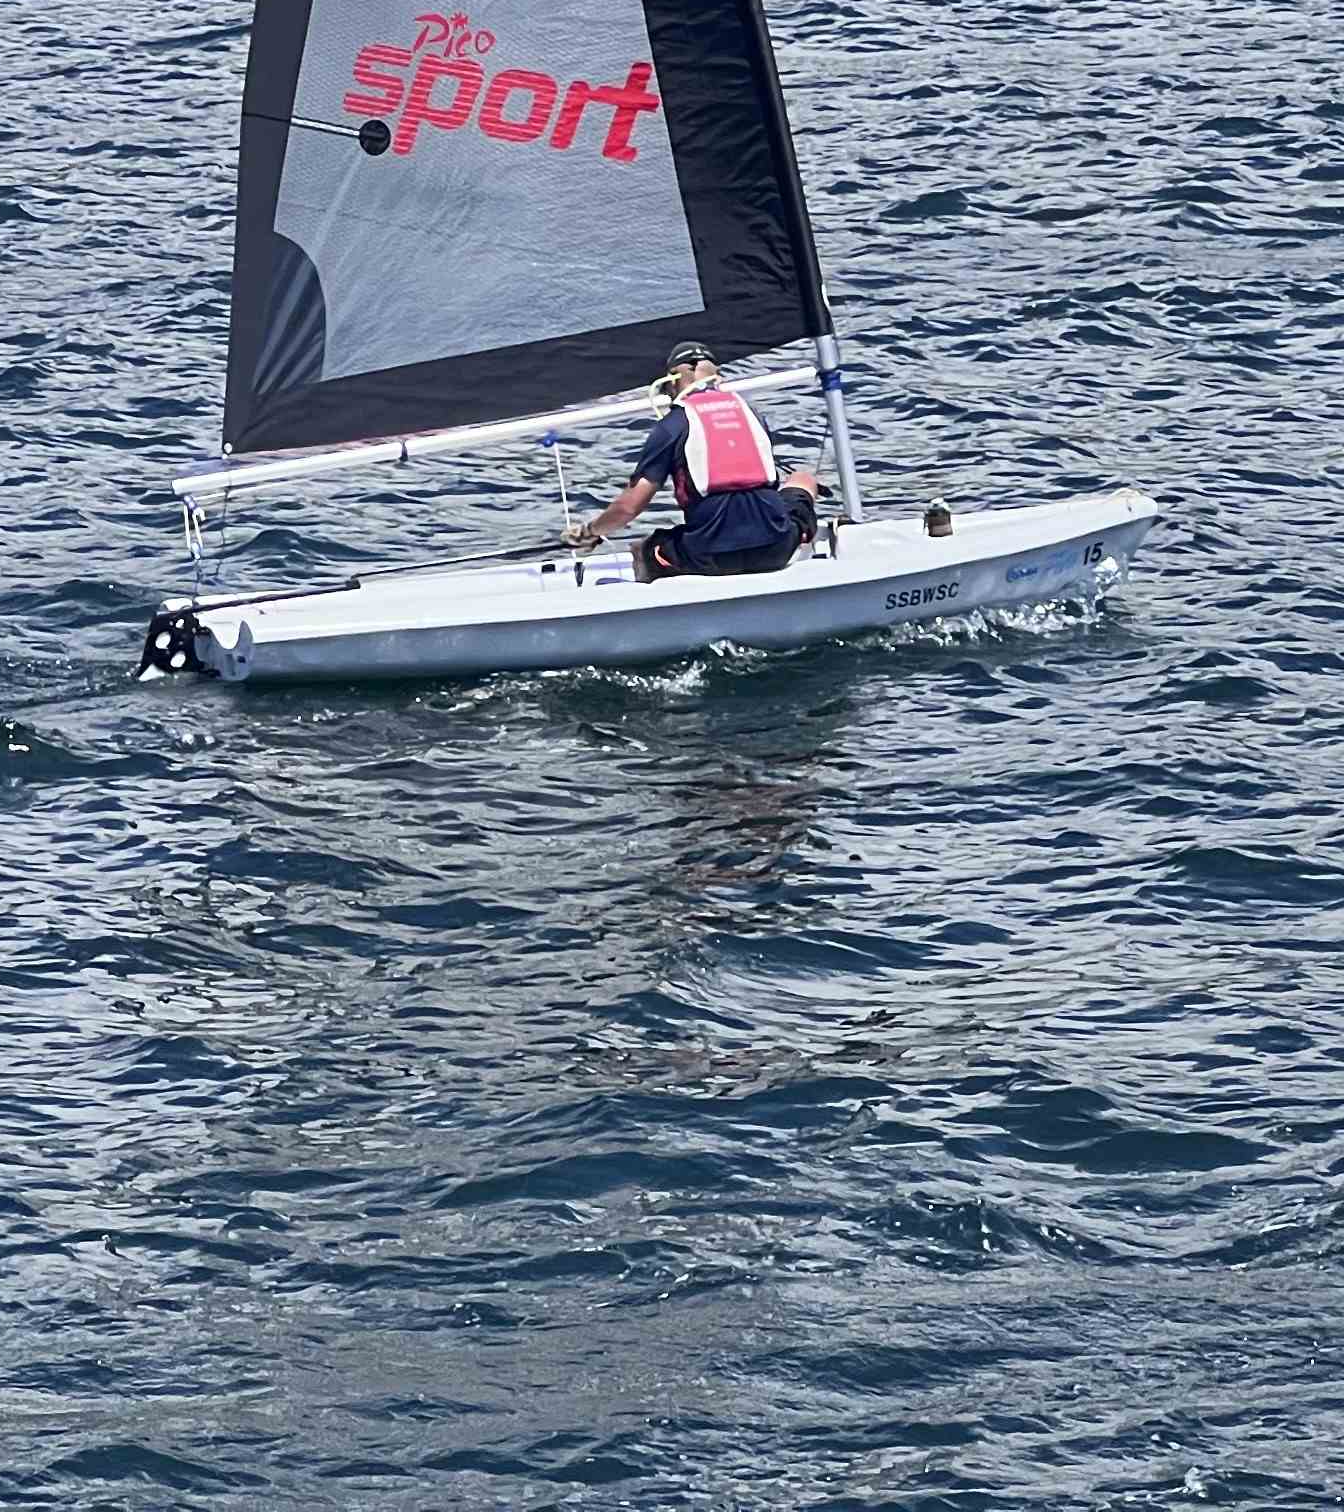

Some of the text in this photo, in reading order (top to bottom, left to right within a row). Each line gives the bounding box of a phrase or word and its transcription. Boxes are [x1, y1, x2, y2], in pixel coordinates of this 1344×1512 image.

[413, 11, 497, 57] Pico
[343, 44, 660, 163] sport
[1082, 541, 1105, 566] 15
[885, 582, 960, 610] SSBWSC
